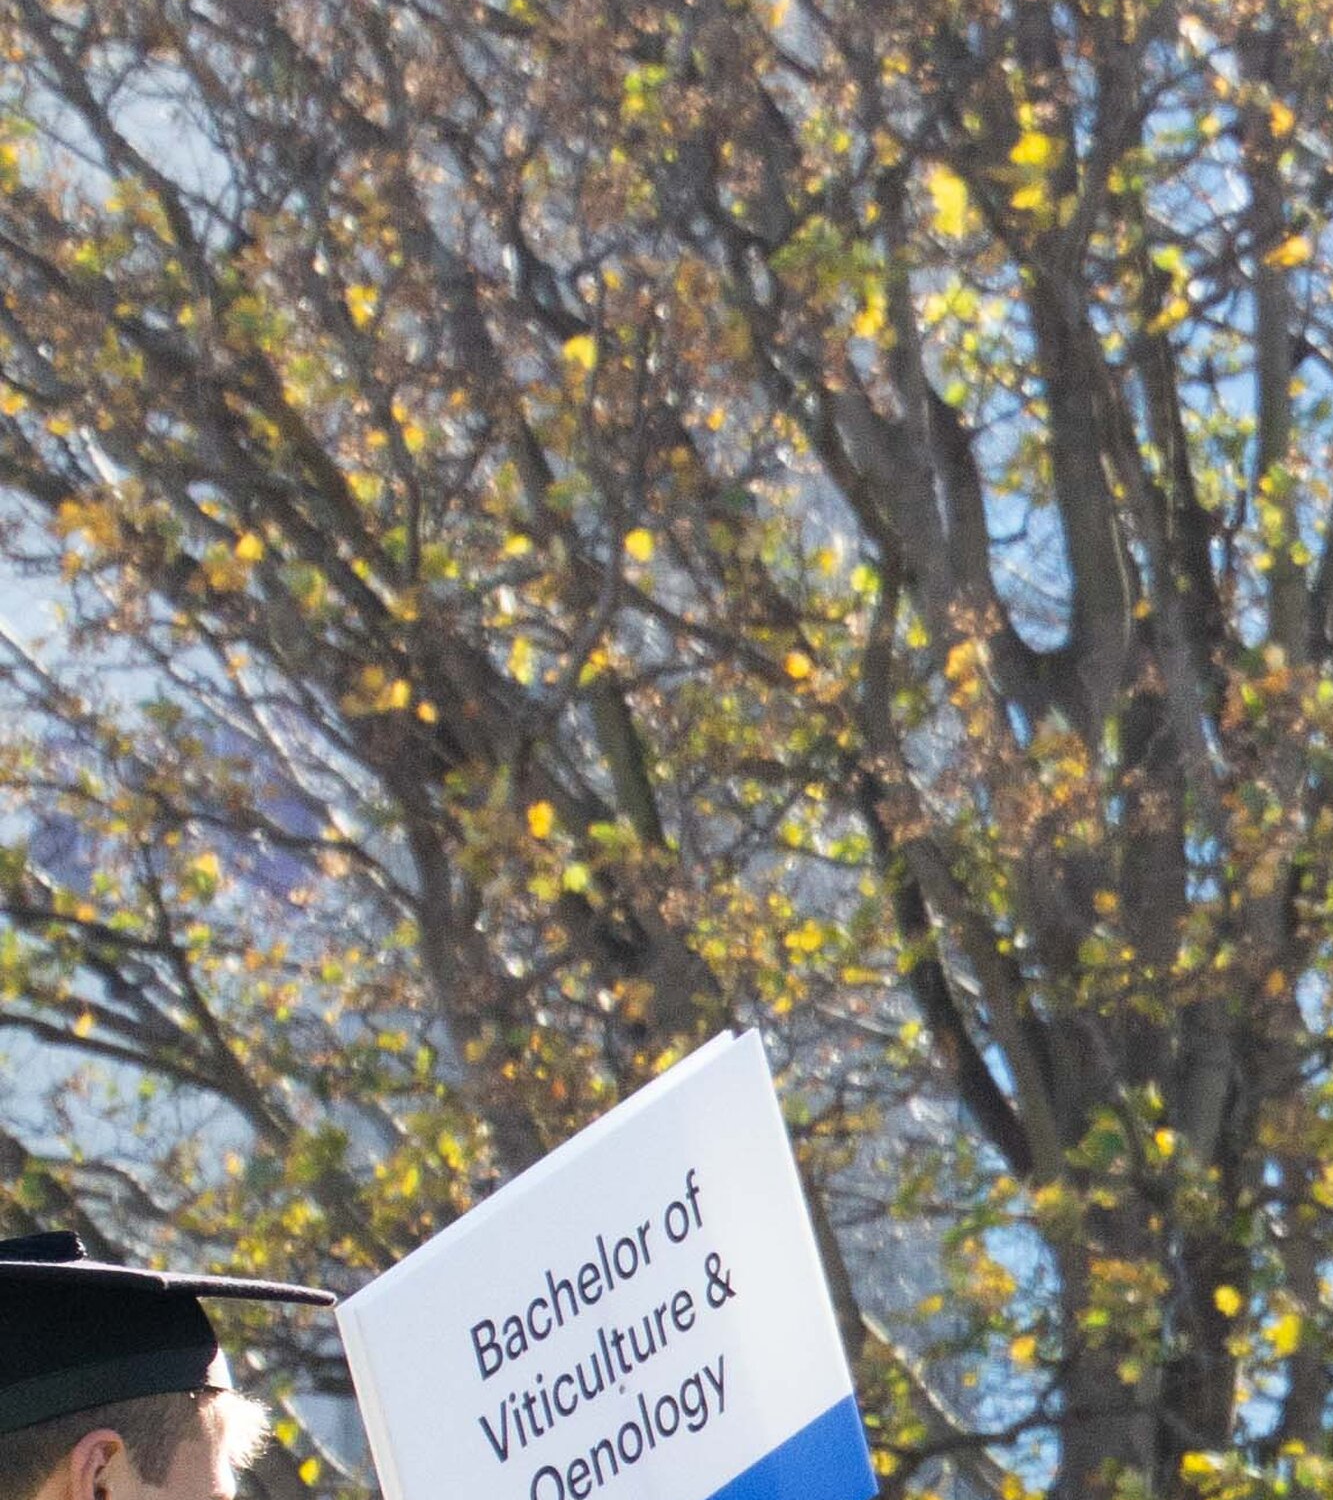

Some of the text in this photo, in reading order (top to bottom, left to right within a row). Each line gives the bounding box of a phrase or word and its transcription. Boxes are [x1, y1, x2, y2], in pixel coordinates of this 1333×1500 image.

[470, 1168, 704, 1381] Bachelor of
[478, 1252, 738, 1464] Viticulture &
